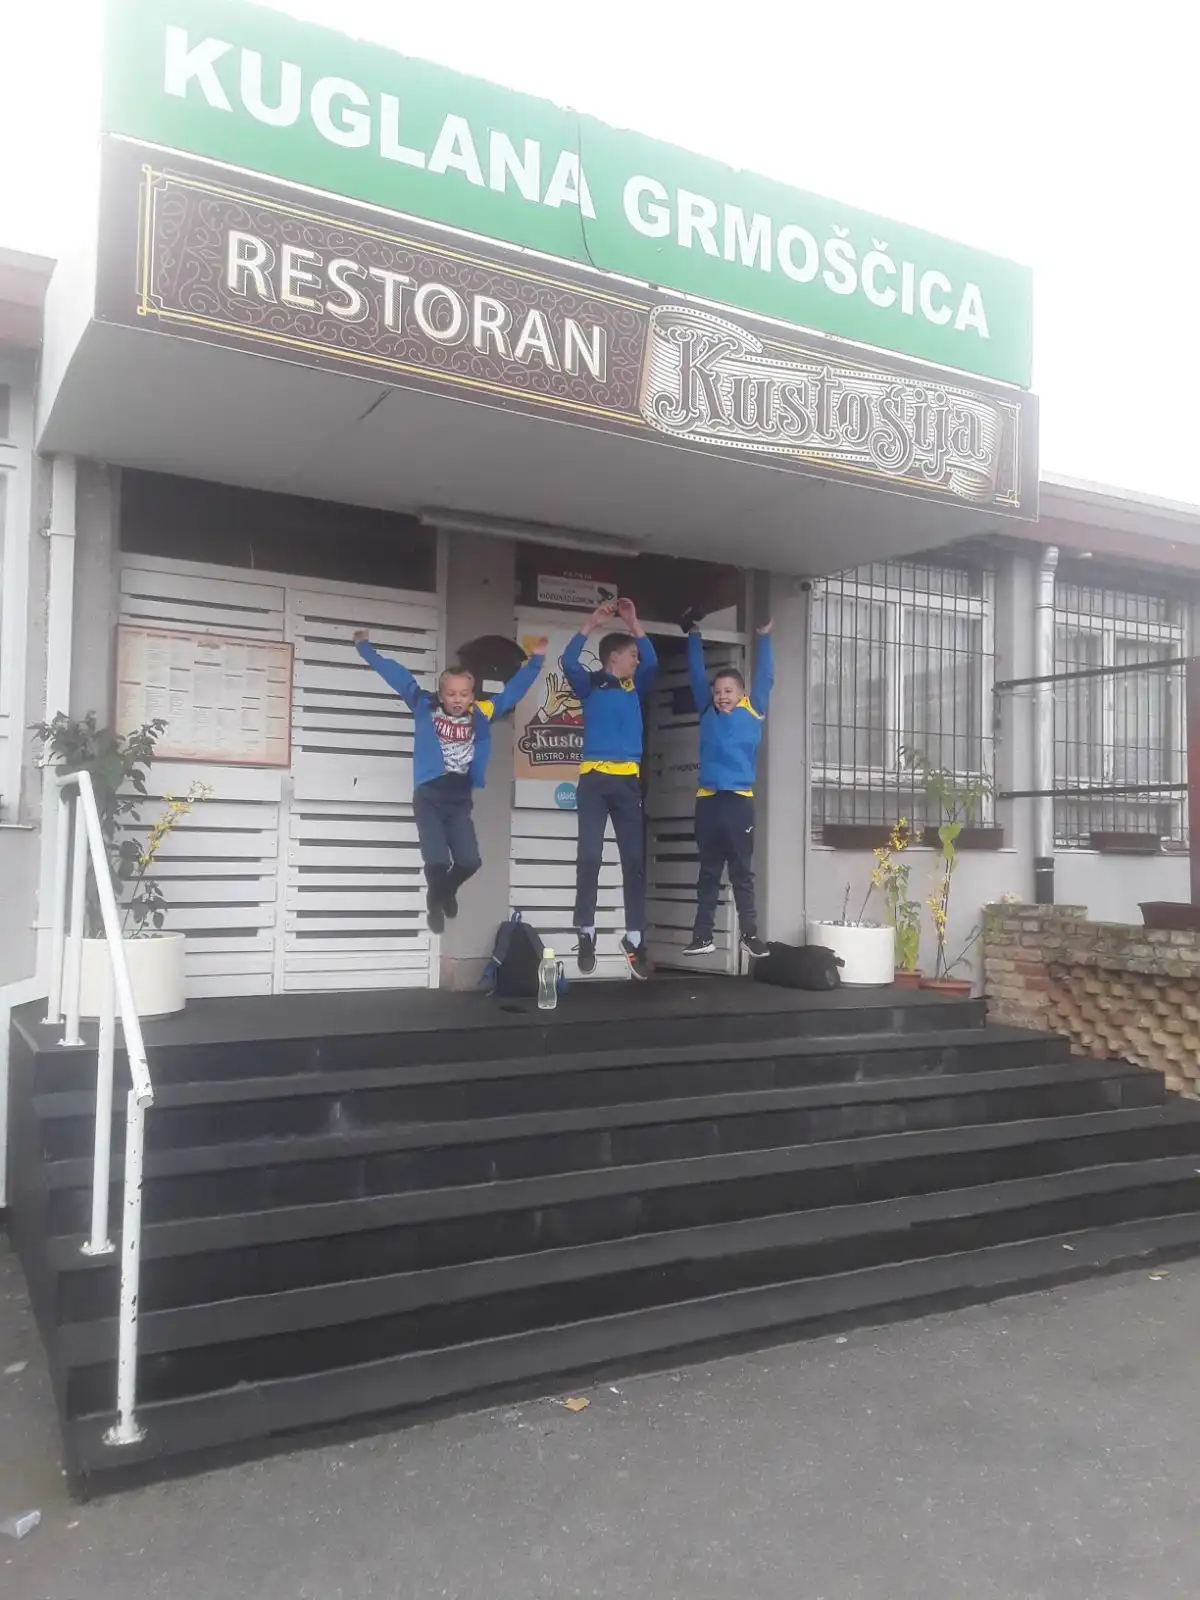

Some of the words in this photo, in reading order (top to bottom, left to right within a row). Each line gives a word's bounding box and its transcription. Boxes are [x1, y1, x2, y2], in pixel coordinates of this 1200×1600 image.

[164, 24, 596, 220] KUGLANA
[622, 175, 990, 339] GRMOŠČICA
[225, 229, 608, 383] RESTORAN
[531, 729, 584, 749] Kusto
[535, 752, 565, 761] BISTRO
[570, 753, 584, 761] RES
